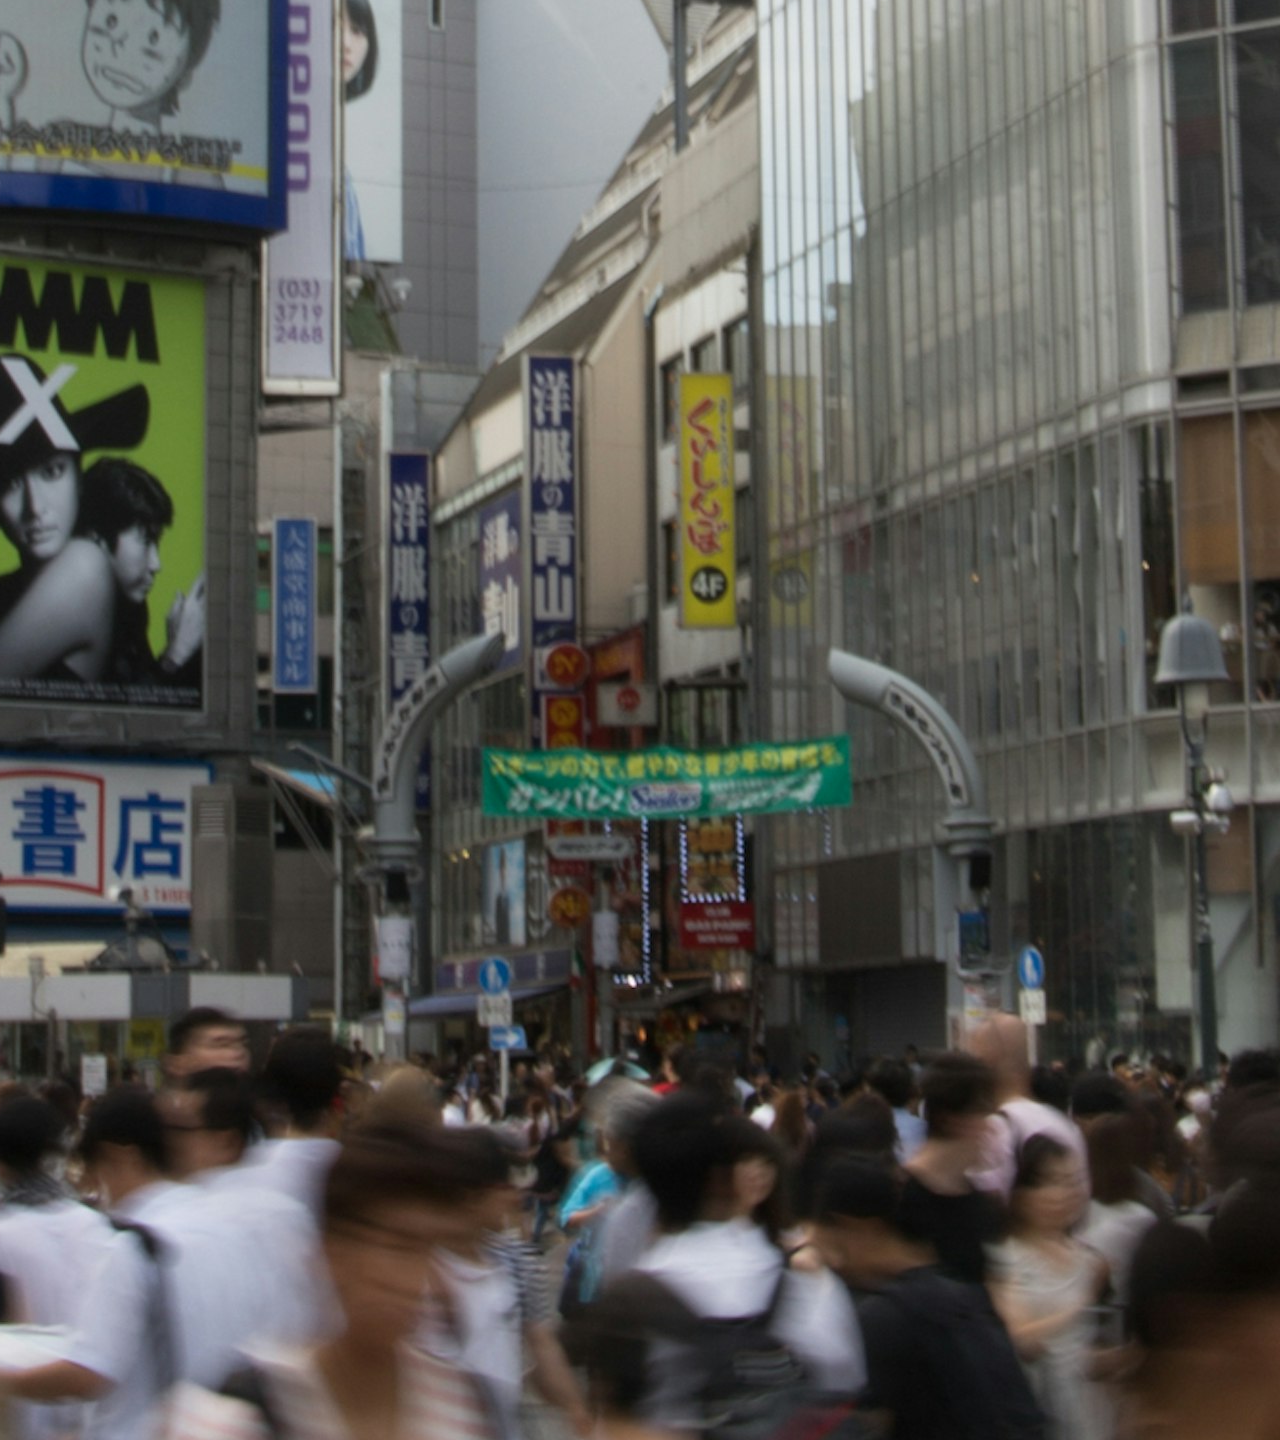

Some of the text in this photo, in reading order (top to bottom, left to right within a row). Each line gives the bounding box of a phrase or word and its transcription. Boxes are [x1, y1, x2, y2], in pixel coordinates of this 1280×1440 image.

[277, 277, 321, 301] (03)
[532, 370, 574, 621] 洋服の青山
[691, 572, 725, 599] 4F
